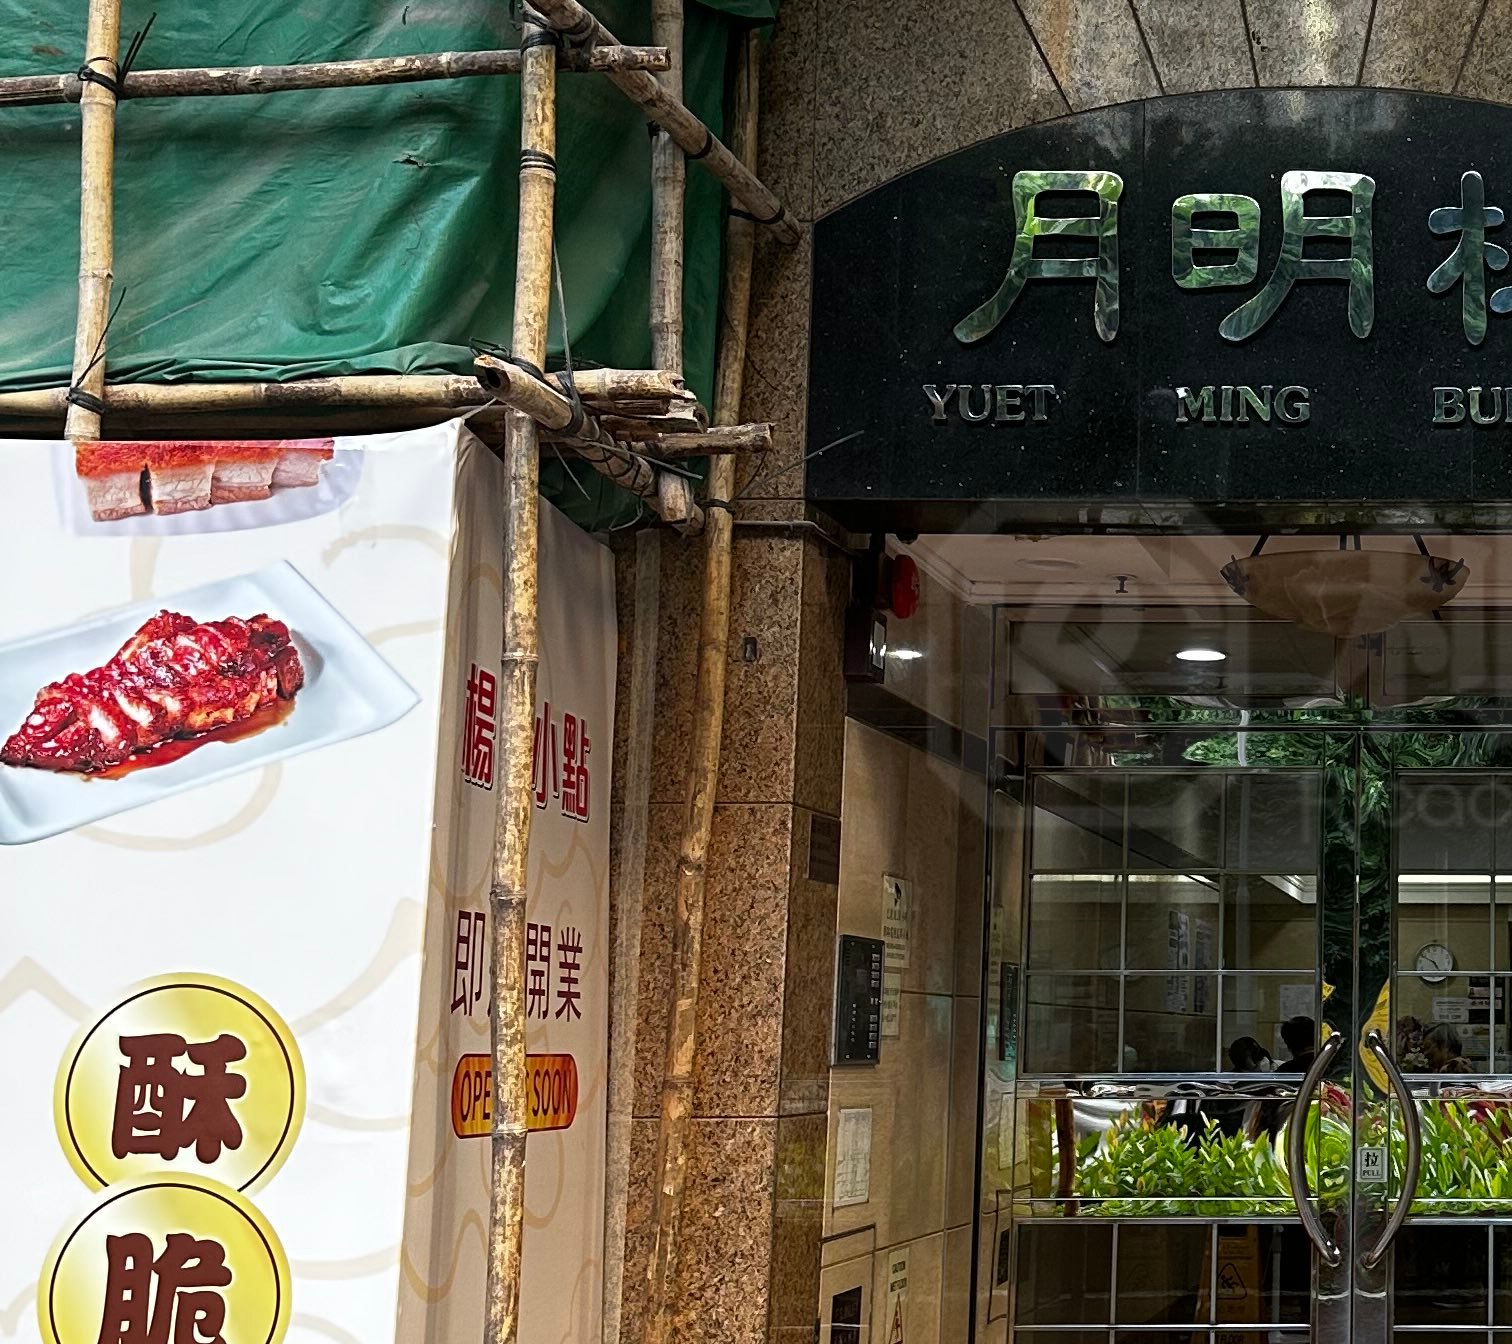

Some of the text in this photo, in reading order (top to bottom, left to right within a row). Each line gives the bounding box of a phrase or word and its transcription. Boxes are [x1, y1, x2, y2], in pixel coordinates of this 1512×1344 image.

[922, 383, 1059, 426] YUET
[1173, 383, 1312, 426] MING
[532, 1068, 572, 1117] SOON
